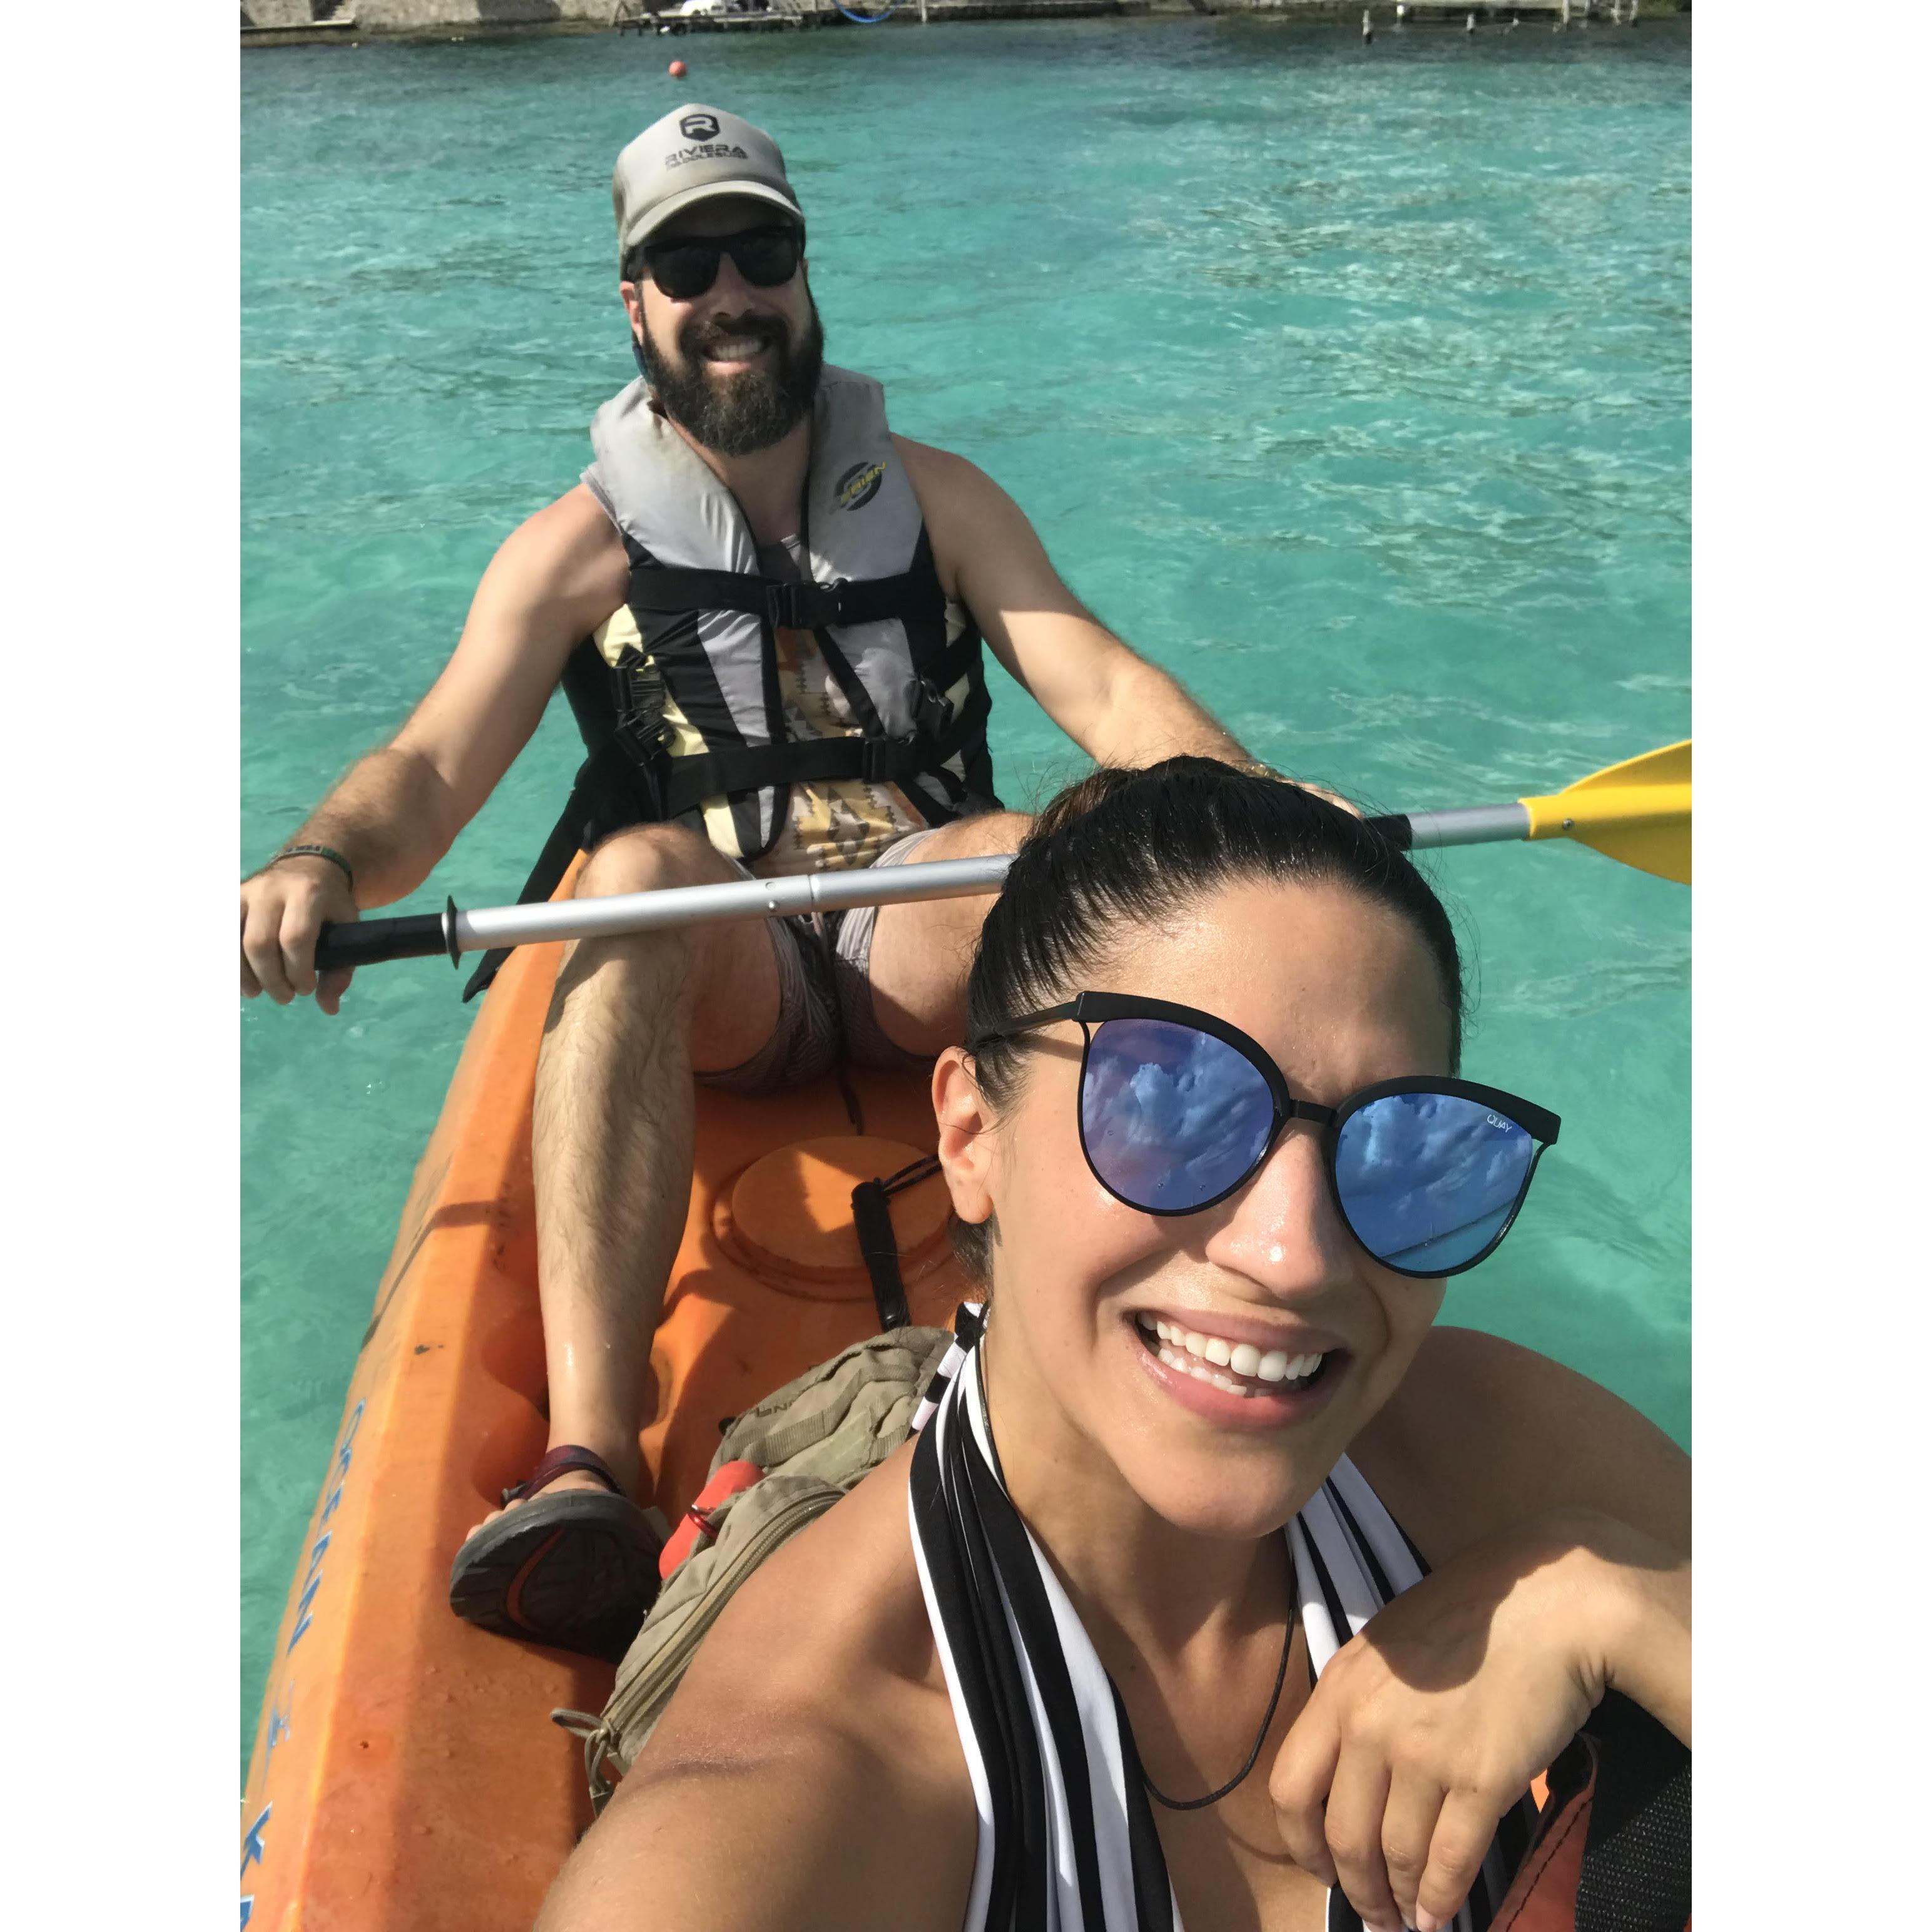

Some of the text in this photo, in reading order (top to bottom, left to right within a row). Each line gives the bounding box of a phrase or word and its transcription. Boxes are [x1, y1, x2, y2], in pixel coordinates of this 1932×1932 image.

[665, 144, 746, 161] RIVIERA
[1487, 1114, 1513, 1133] QUAY
[286, 1396, 366, 1656] OCEAN
